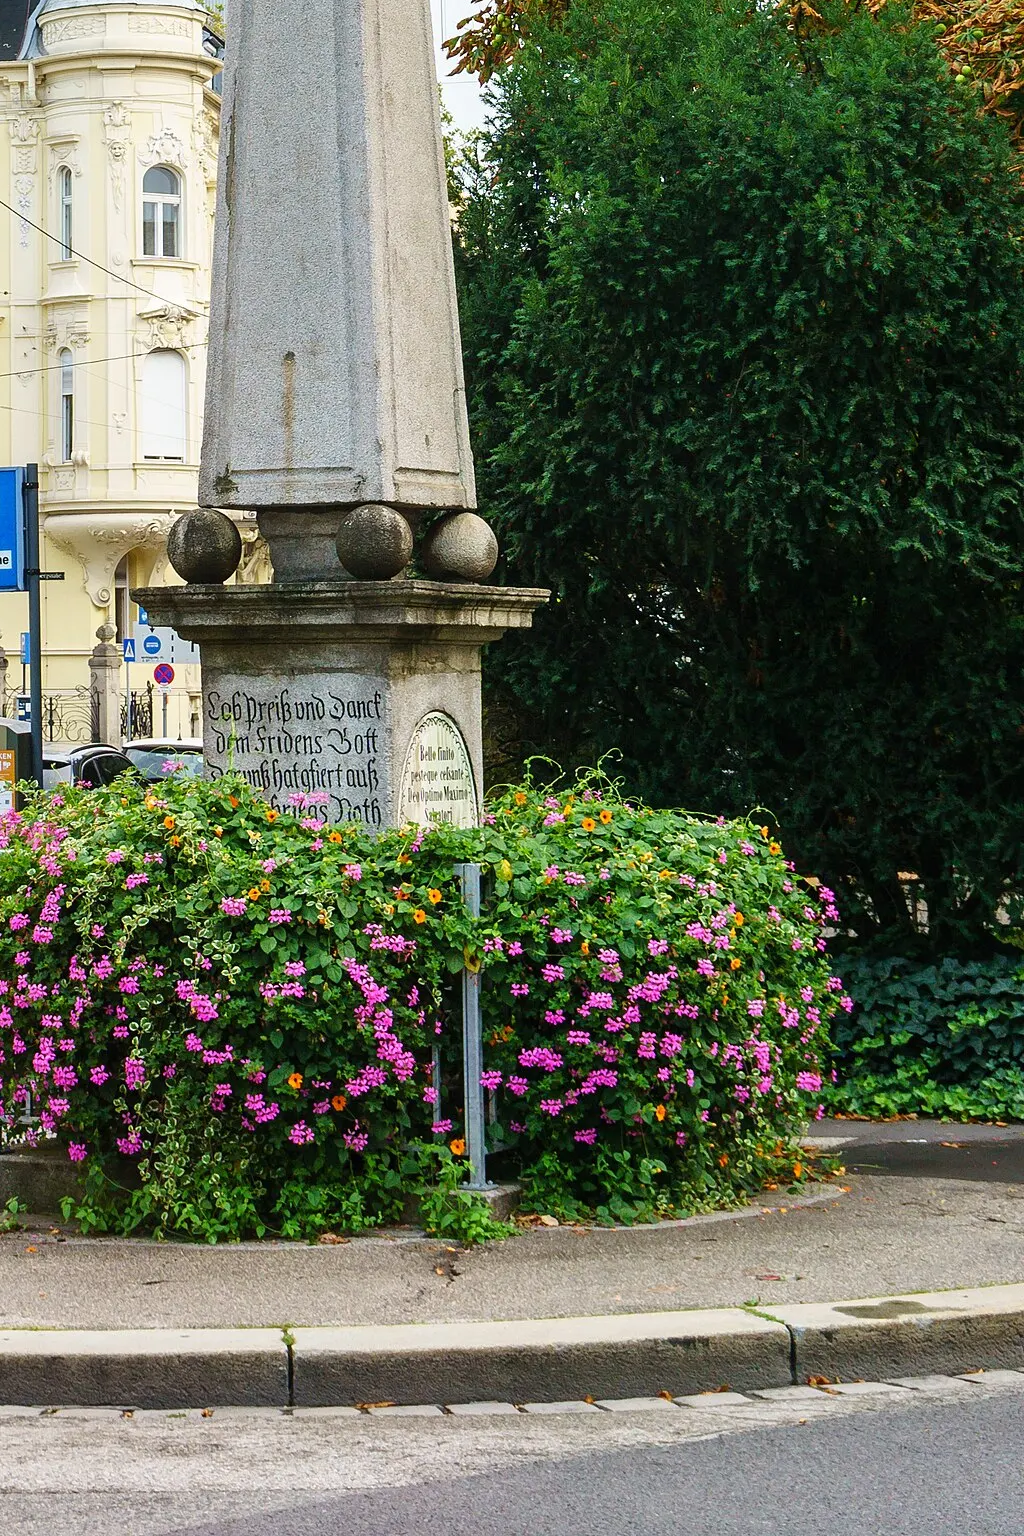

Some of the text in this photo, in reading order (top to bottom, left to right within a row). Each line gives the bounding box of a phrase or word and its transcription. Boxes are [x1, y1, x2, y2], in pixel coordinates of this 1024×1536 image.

[208, 691, 242, 721] Lob
[420, 745, 437, 761] Bello
[408, 786, 468, 805] Deo Optimo Maximo
